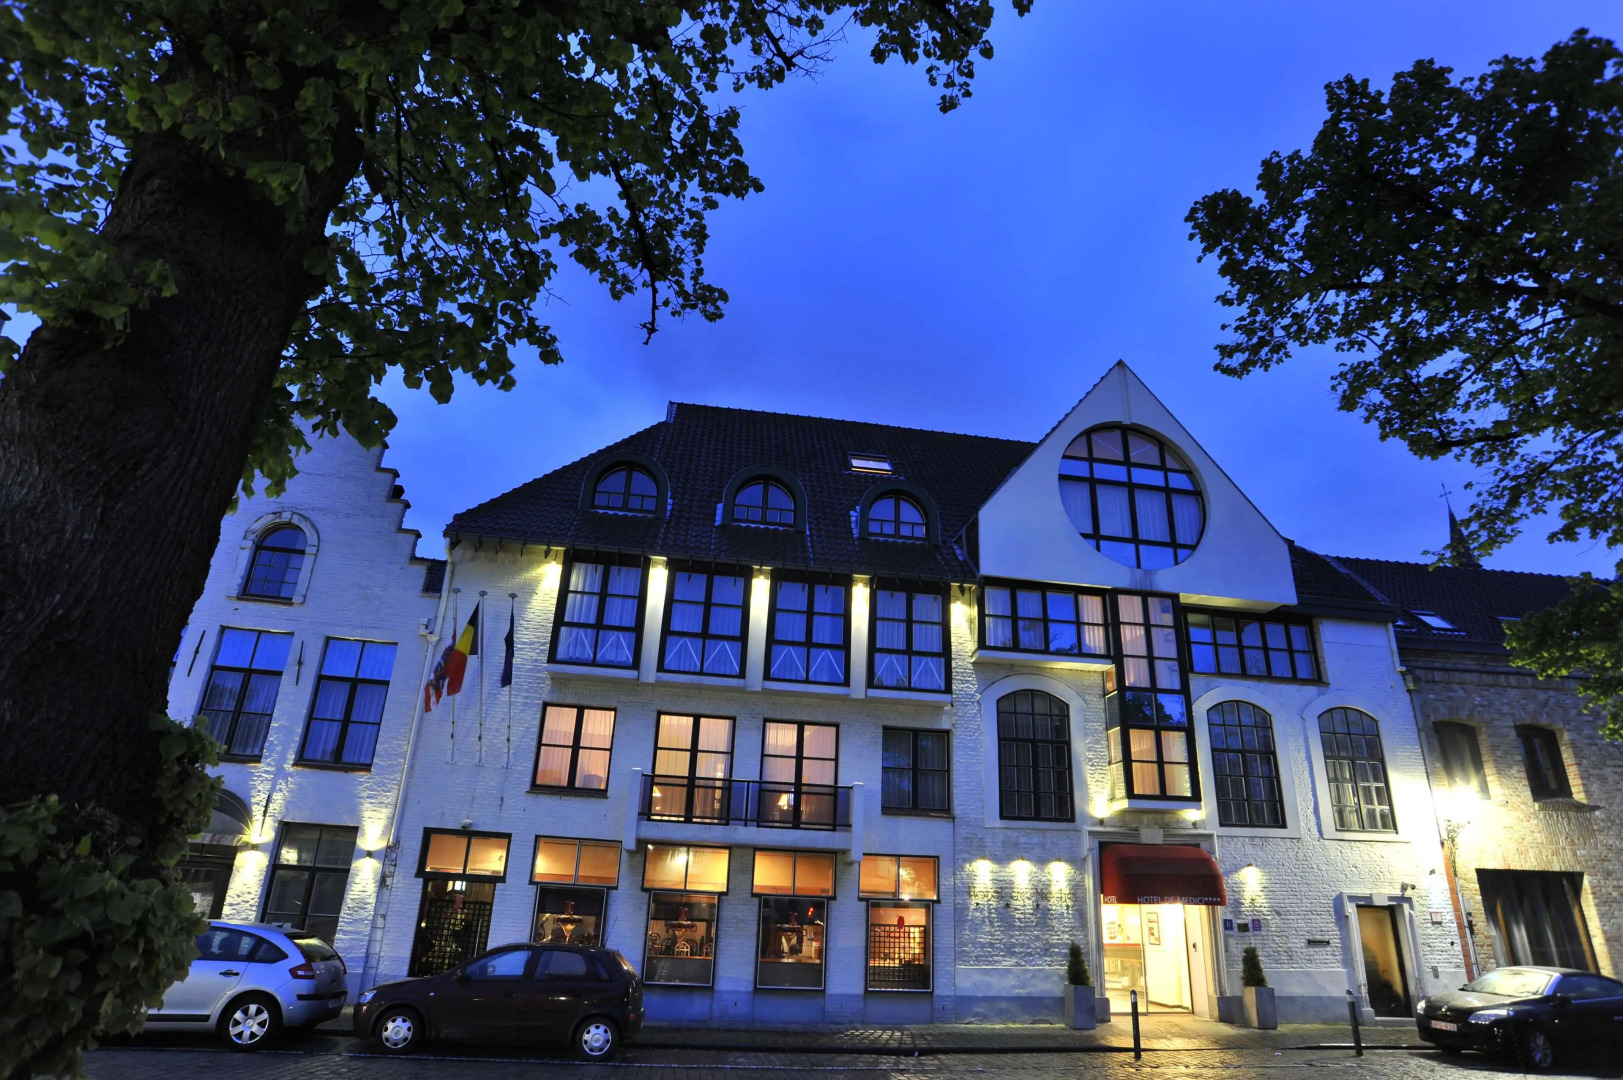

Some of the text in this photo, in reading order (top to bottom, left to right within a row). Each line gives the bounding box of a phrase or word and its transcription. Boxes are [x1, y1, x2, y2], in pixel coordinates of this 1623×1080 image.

[1105, 896, 1118, 904] HOTEL
[1137, 896, 1161, 904] HOTEL
[1164, 896, 1176, 904] DE
